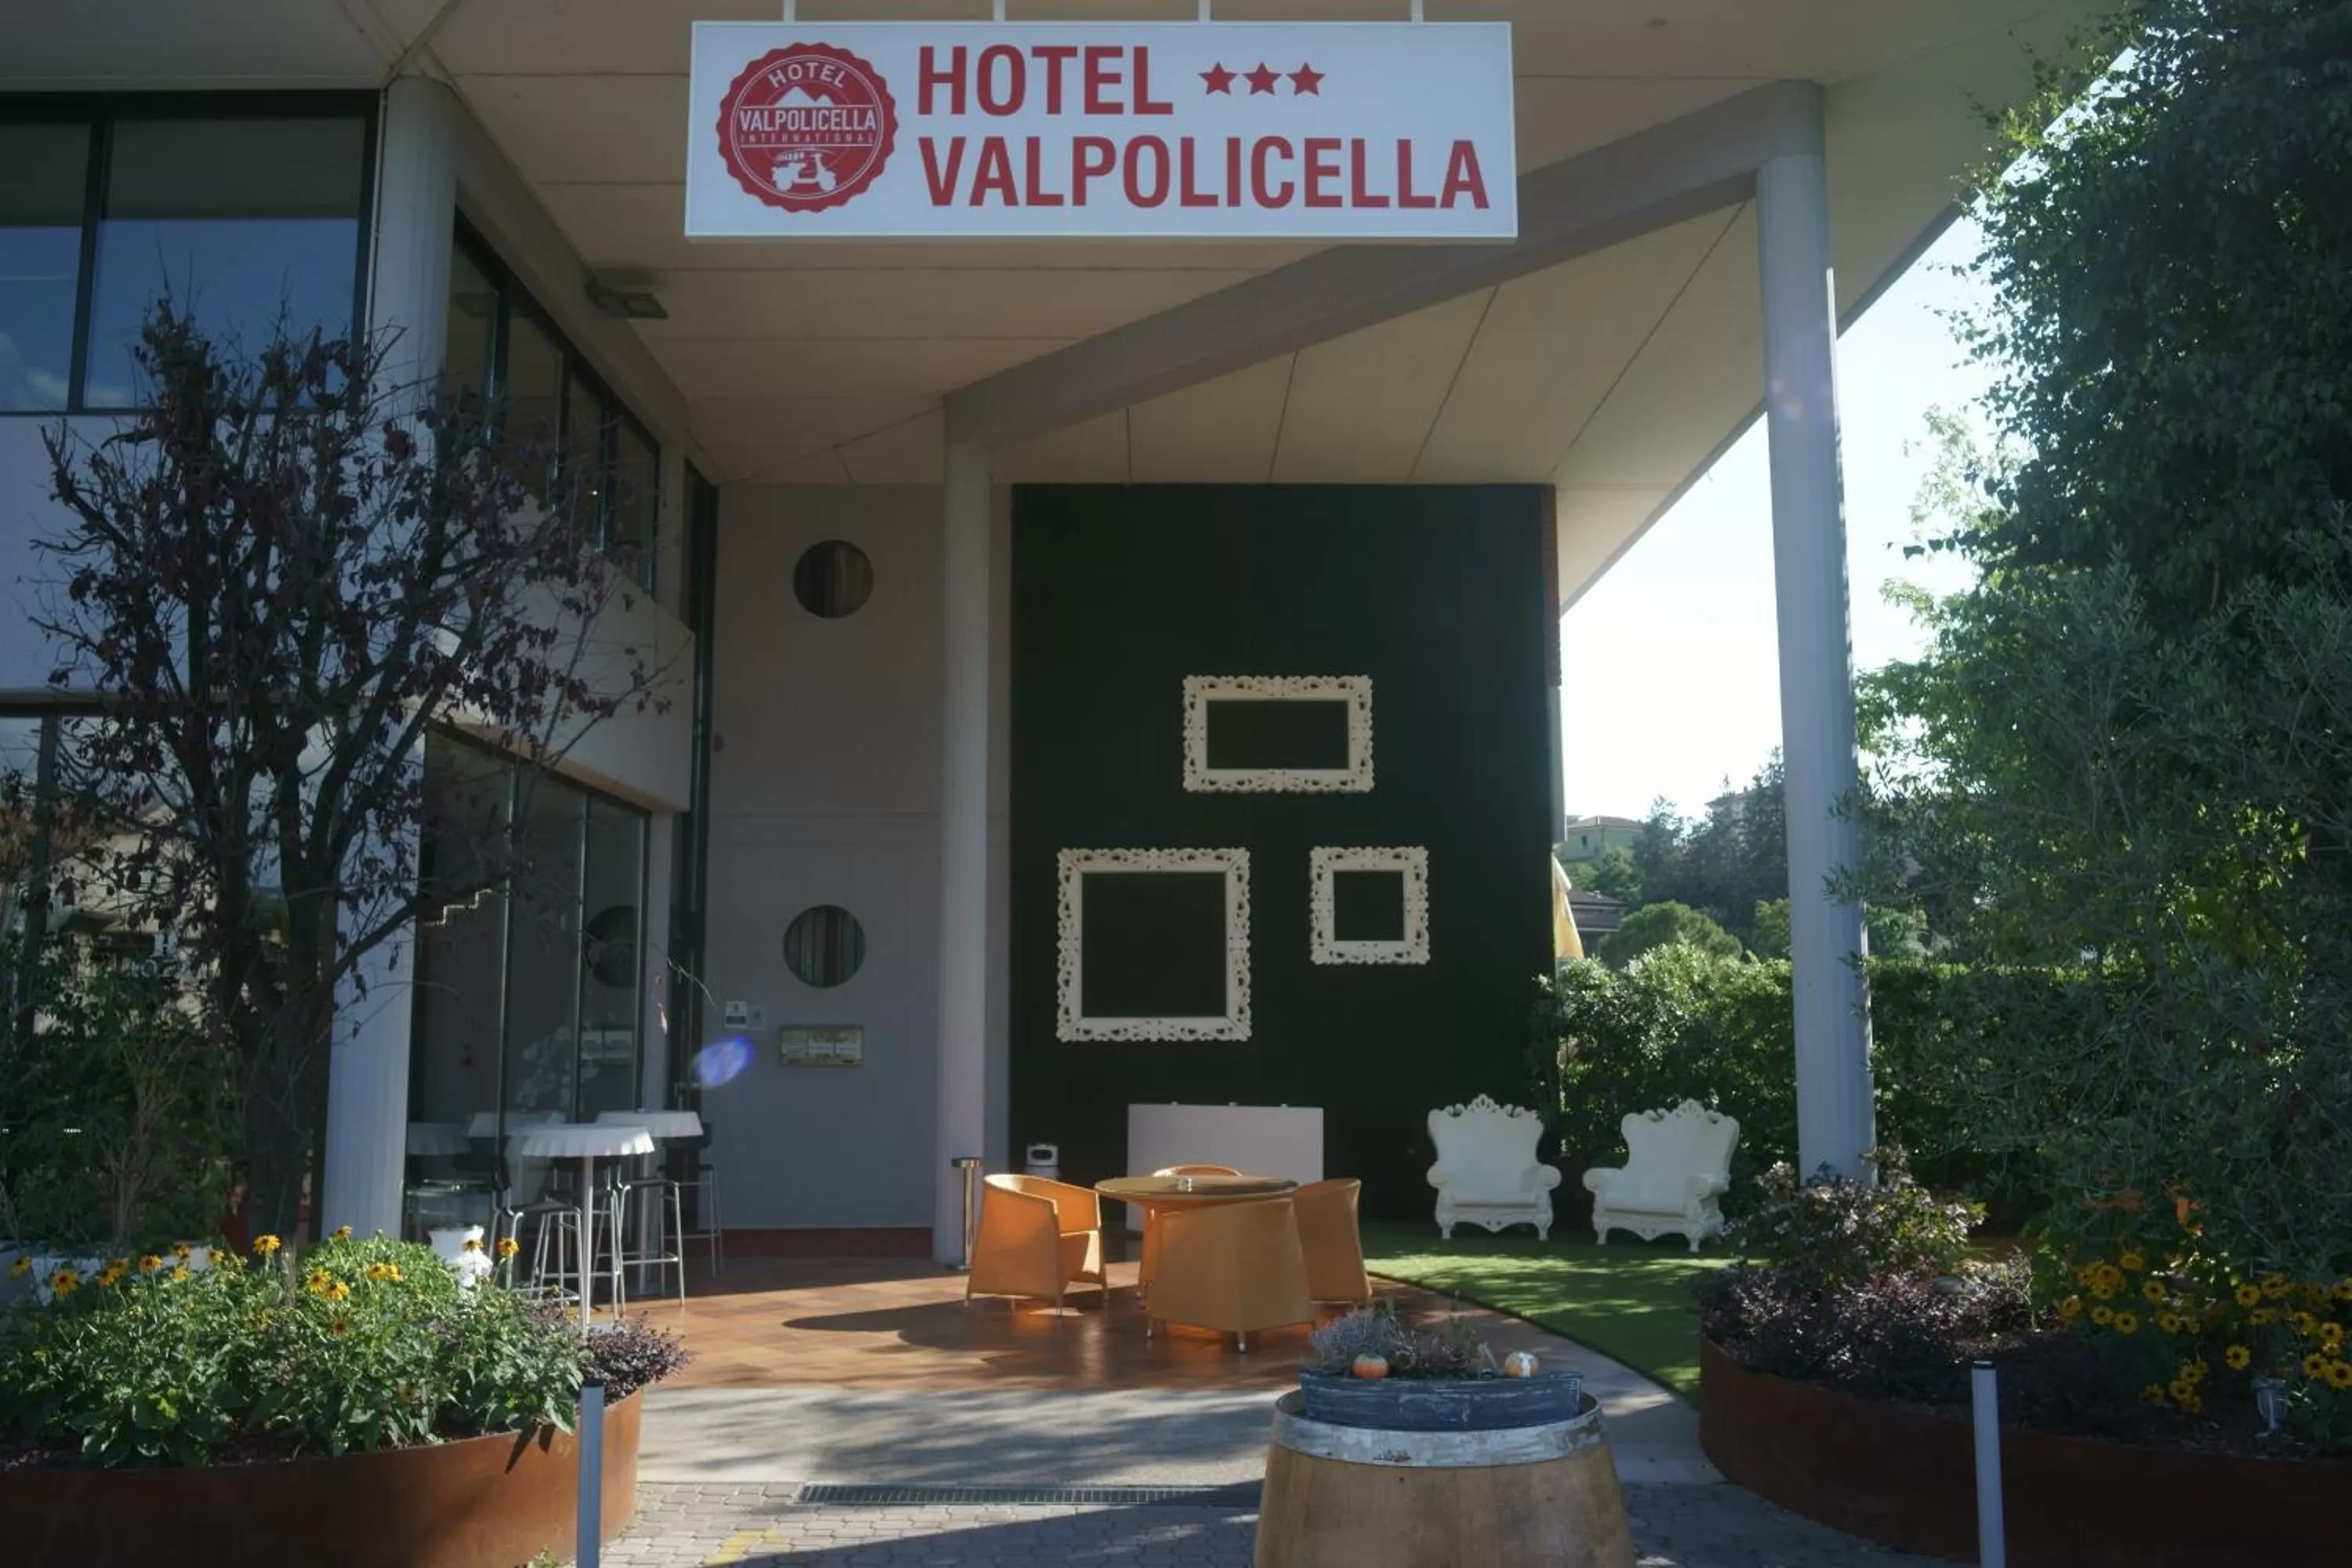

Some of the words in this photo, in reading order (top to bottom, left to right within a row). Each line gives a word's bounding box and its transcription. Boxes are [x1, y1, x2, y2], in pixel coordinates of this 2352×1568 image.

[768, 62, 847, 89] HOTEL
[918, 44, 1174, 116] HOTEL
[739, 108, 877, 132] VALPOLICELLA
[740, 132, 874, 144] INTERNATIONAL
[918, 135, 1490, 209] VALPOLICELLA
